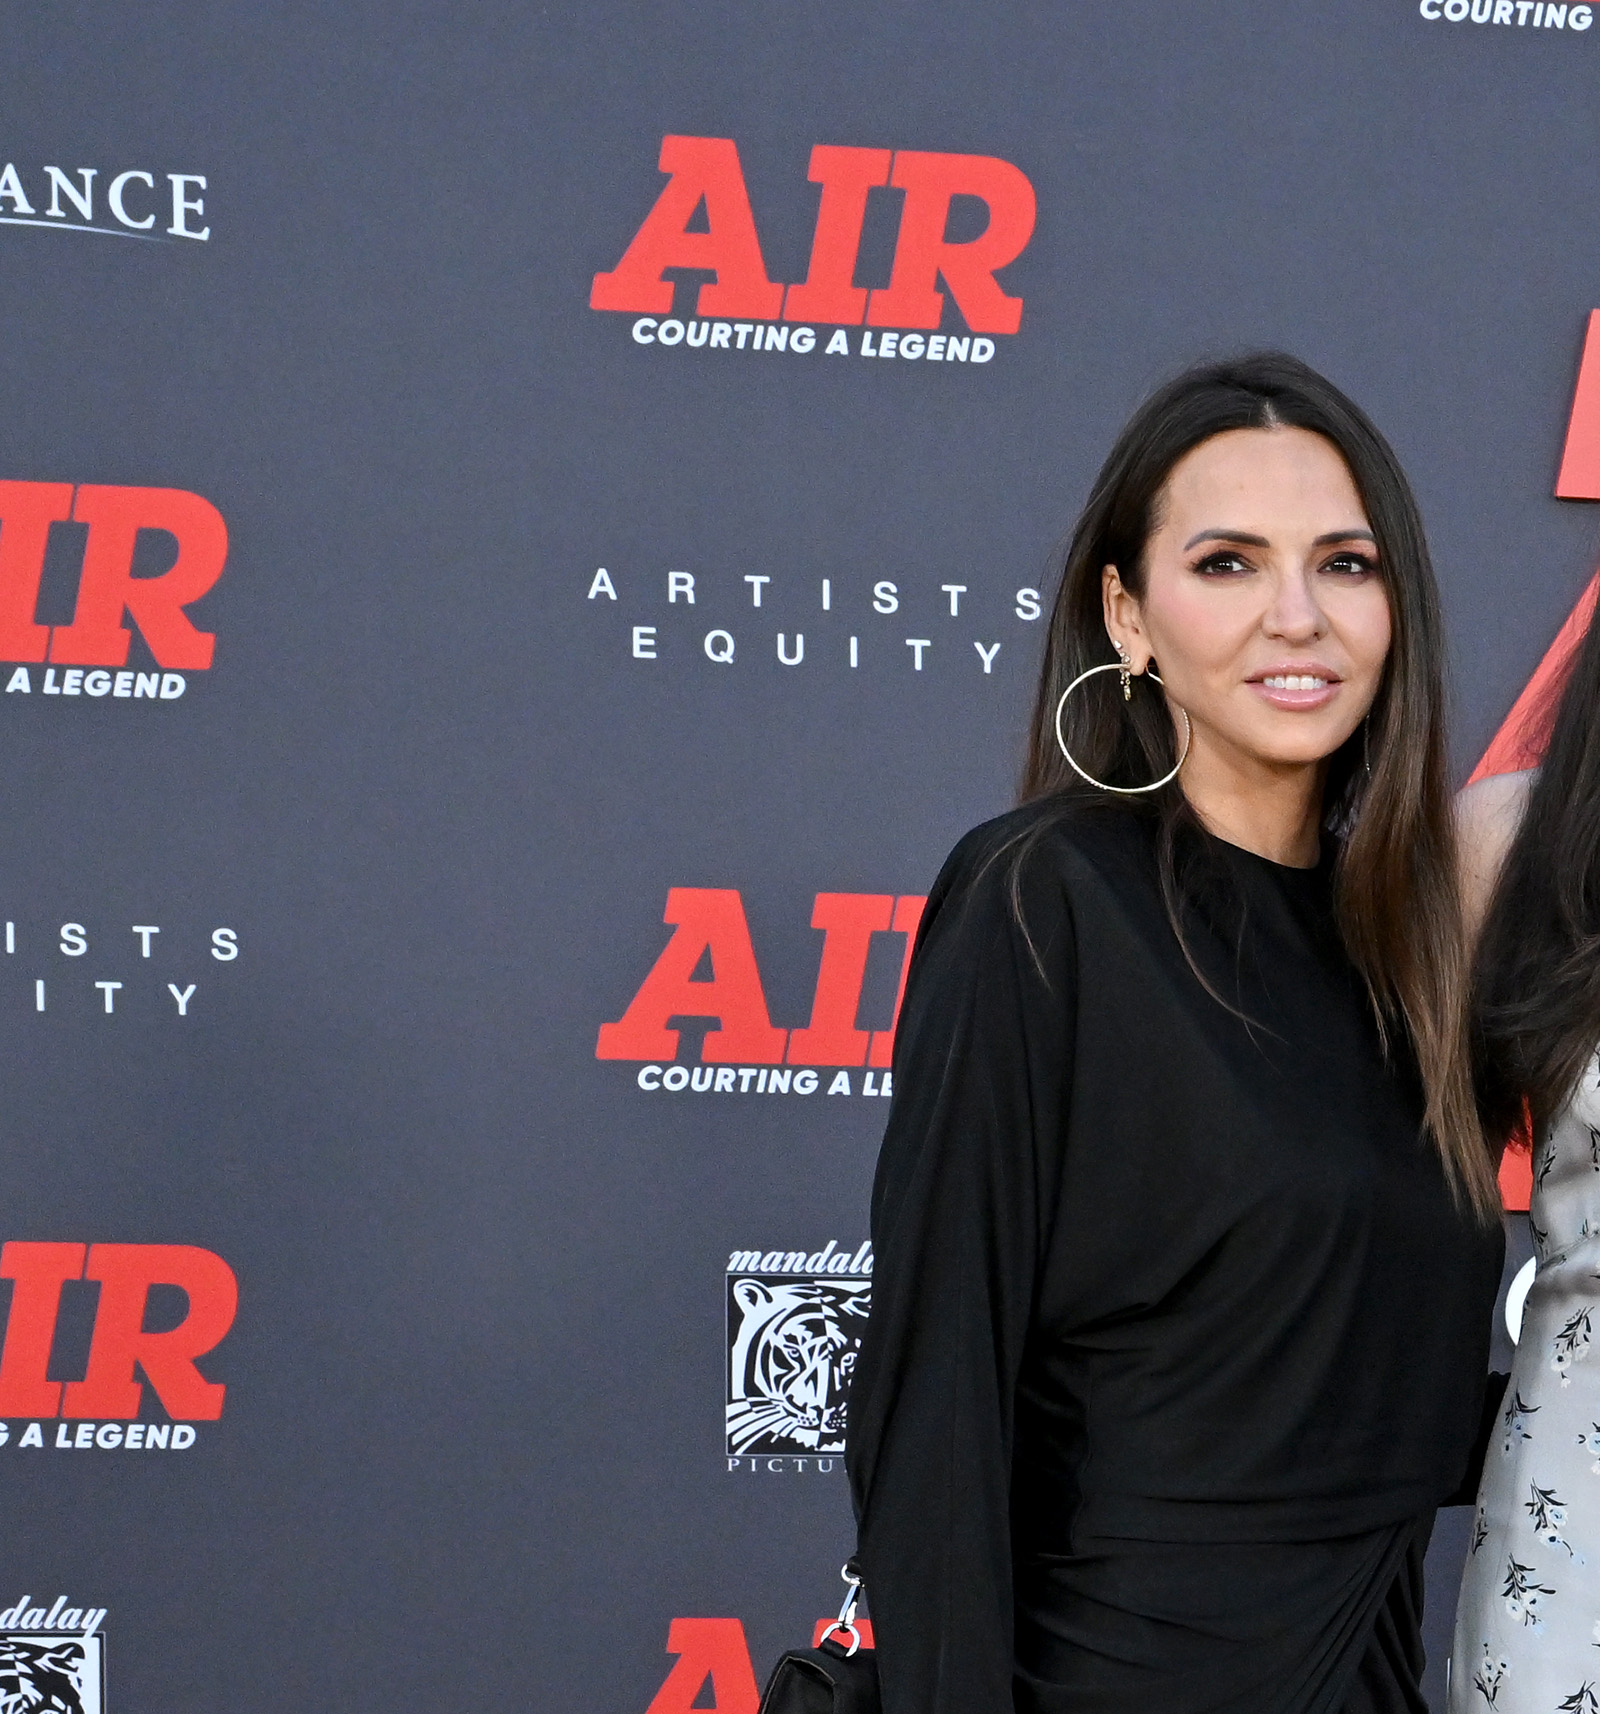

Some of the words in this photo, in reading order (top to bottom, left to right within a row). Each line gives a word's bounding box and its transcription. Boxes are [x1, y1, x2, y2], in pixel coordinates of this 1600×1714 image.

[591, 135, 1036, 334] AIR
[632, 318, 816, 353] COURTING
[825, 329, 848, 355] A
[861, 331, 995, 363] LEGEND
[588, 568, 1041, 620] ARTISTS
[633, 626, 1000, 673] EQUITY
[5, 667, 31, 693] A
[43, 668, 185, 699] LEGEND
[596, 888, 928, 1067] AI
[638, 1065, 818, 1094] COURTING
[827, 1071, 850, 1095] A
[19, 1423, 43, 1447] A
[56, 1424, 195, 1449] LEGEND
[728, 1458, 832, 1472] PICTU
